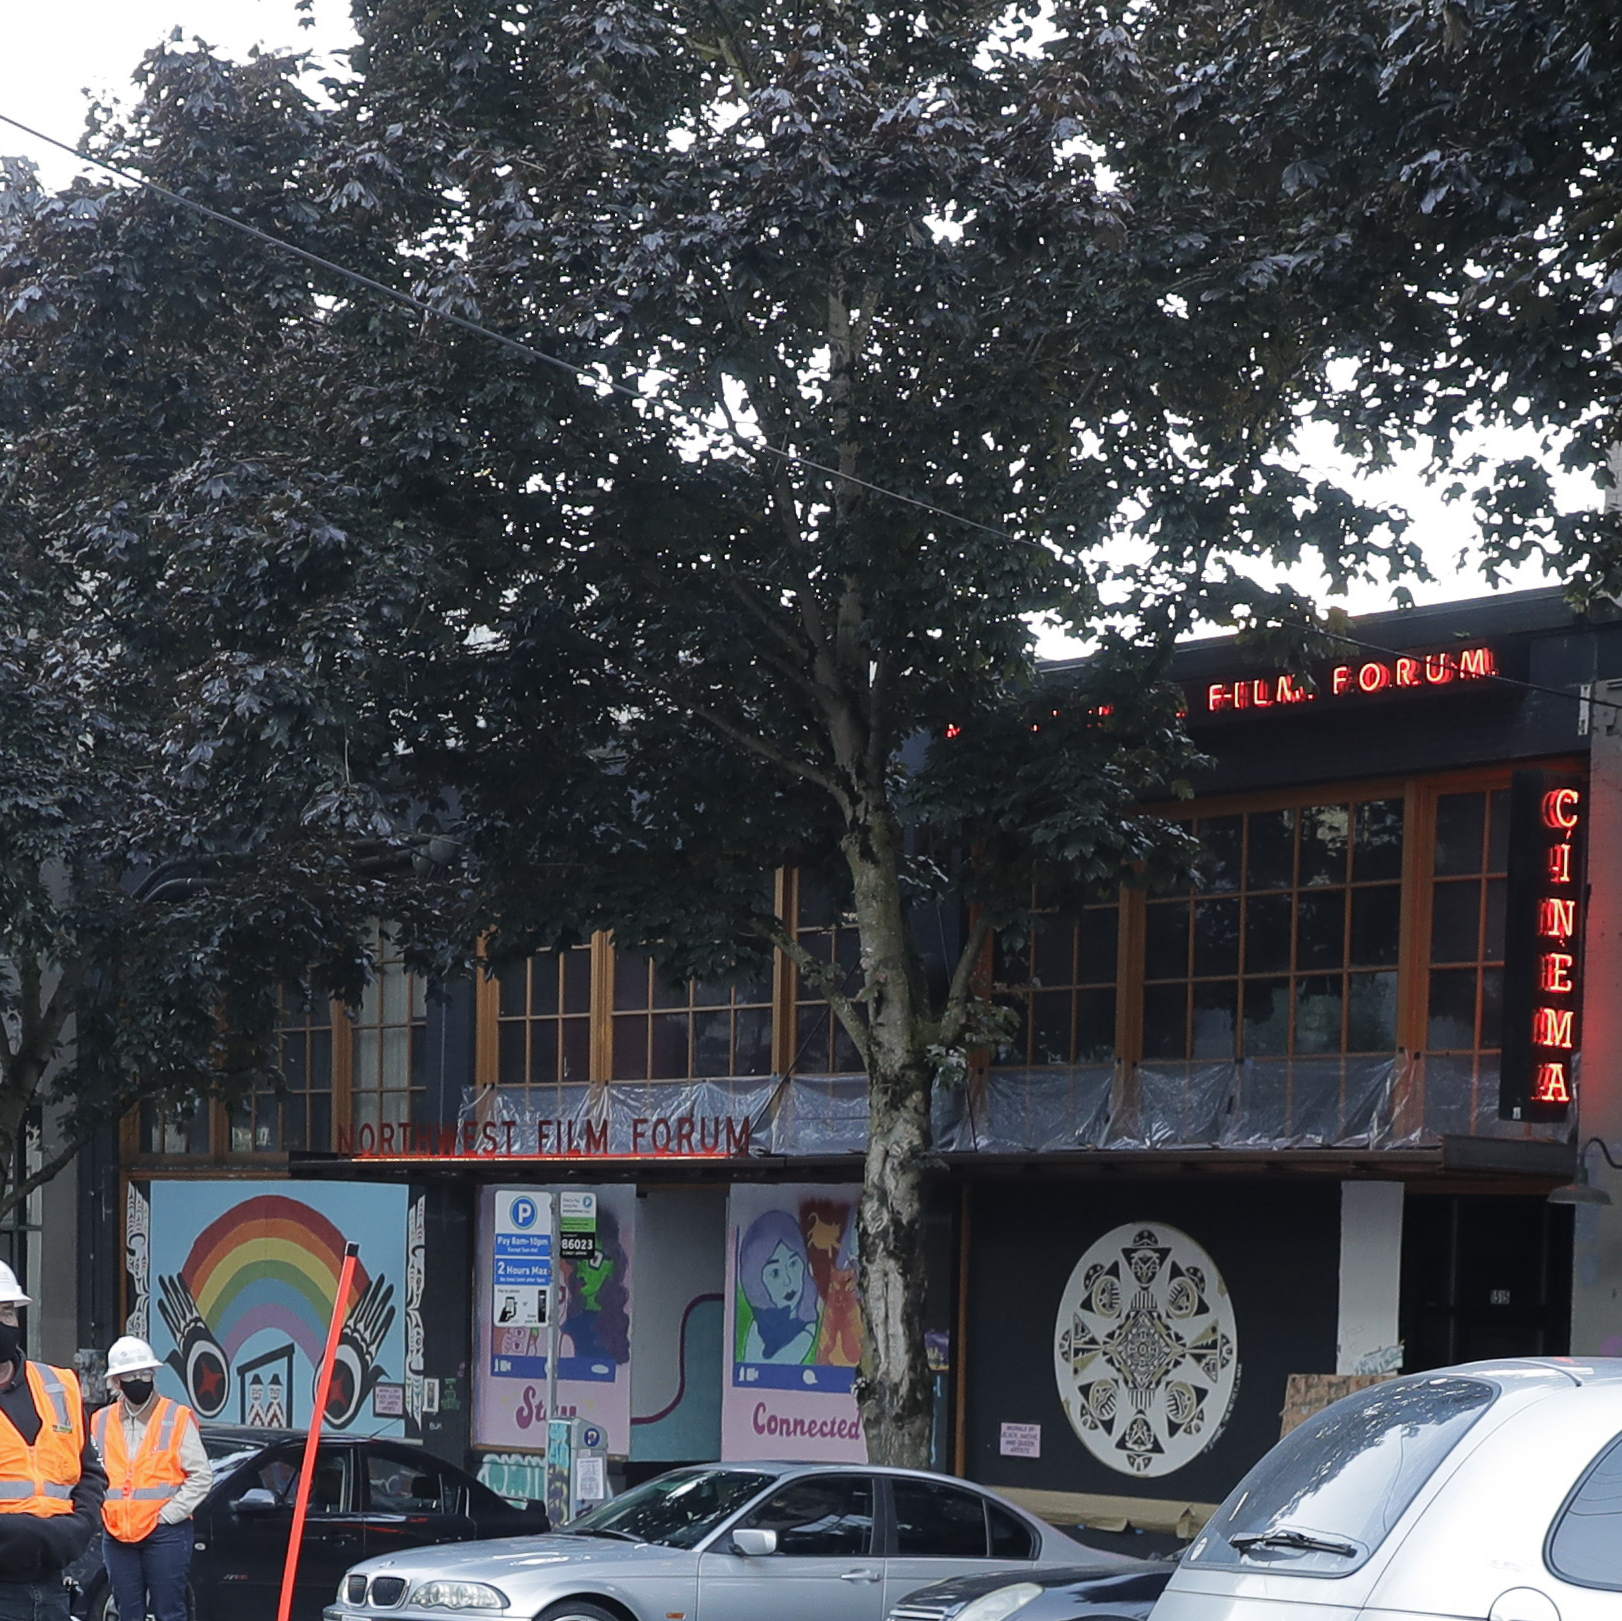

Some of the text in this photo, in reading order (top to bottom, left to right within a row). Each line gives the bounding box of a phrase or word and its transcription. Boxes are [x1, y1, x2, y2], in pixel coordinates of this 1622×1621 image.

[1208, 648, 1497, 713] FILM FORUM
[1542, 788, 1580, 1102] CINEMA
[336, 1116, 750, 1157] NORTHWEST FILM FORUM
[518, 1203, 532, 1223] P
[561, 1239, 593, 1250] 86023
[497, 1261, 548, 1275] 2 Hours Max
[753, 1402, 862, 1440] Connected
